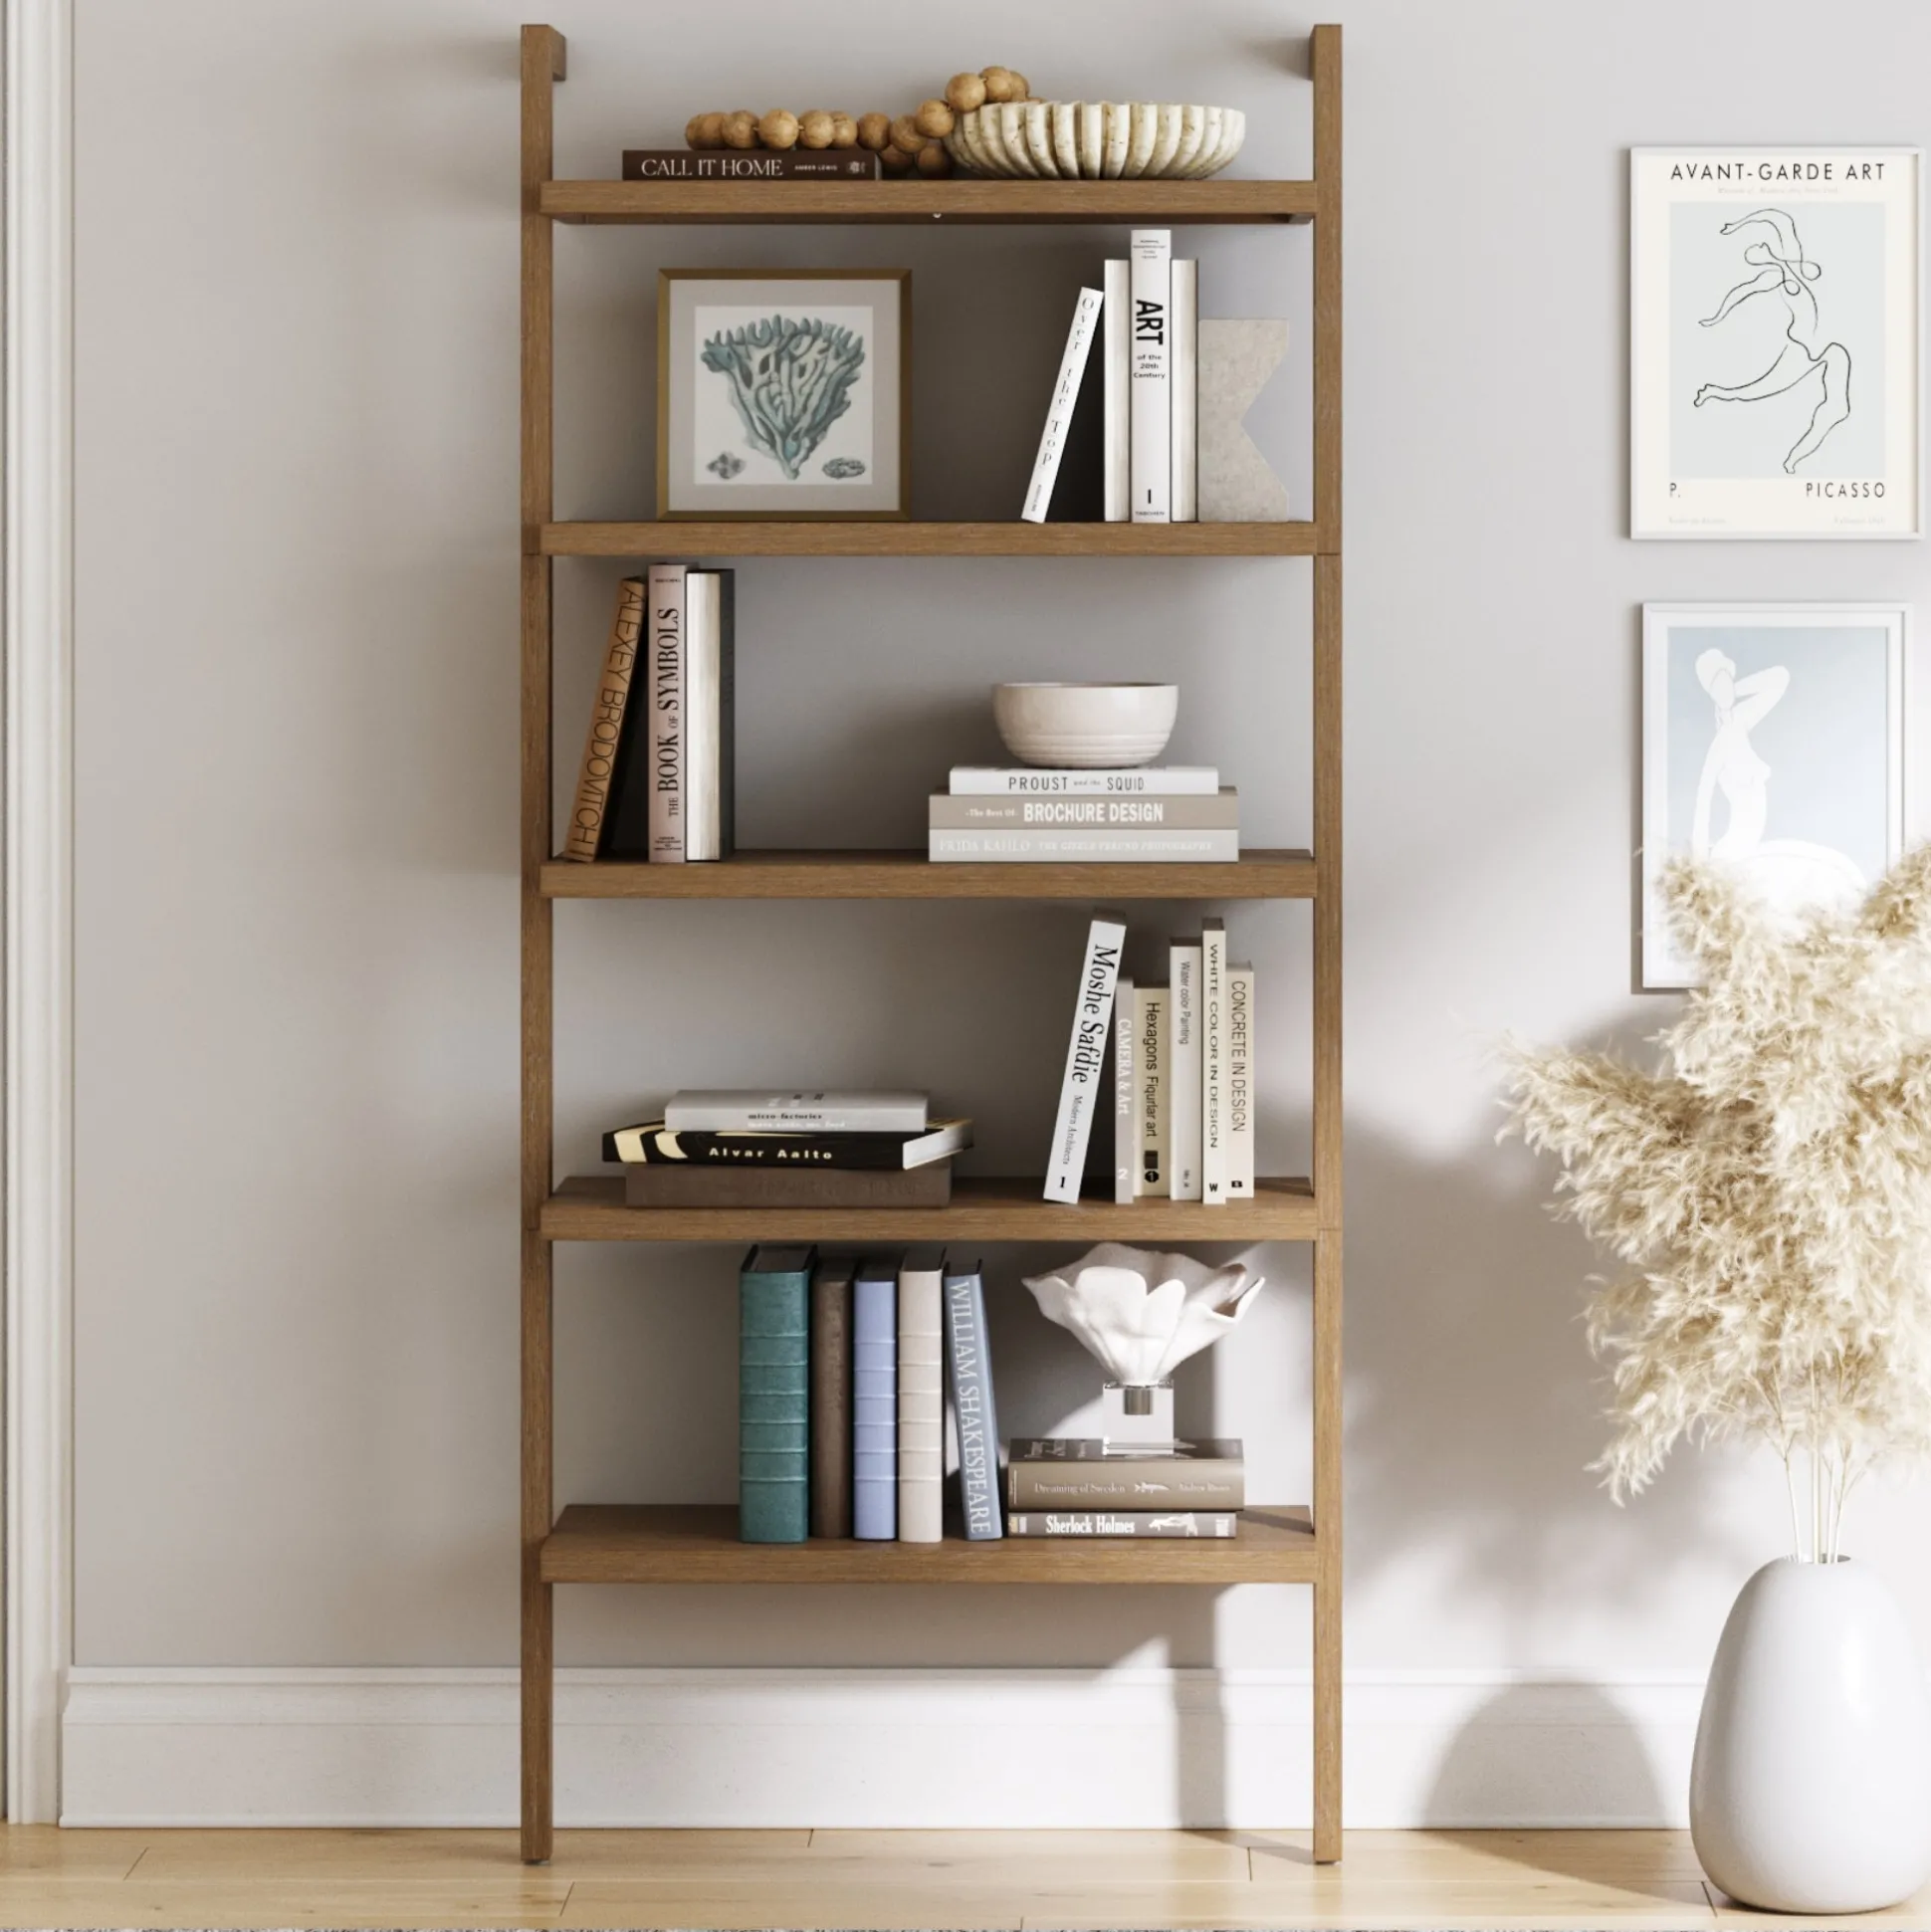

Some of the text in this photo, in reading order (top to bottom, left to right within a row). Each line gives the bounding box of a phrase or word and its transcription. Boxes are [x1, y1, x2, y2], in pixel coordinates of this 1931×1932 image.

[641, 158, 783, 176] CALL IT HOME
[1670, 162, 1885, 181] AVANT-GARDE ART
[1136, 299, 1164, 345] ART
[1133, 371, 1167, 380] Century
[1668, 482, 1681, 499] P.
[1806, 482, 1885, 499] PICASSO
[657, 607, 679, 711] SYMBOLS
[571, 587, 644, 845] ALEXEY BRODOVITCH
[657, 735, 679, 793] BOOK
[1008, 776, 1068, 791] PROUST
[1107, 776, 1145, 791] SQUID
[668, 797, 679, 818] THE
[1024, 803, 1164, 822] BROCHURE DESIGN
[939, 839, 979, 852] FRIDA
[983, 839, 1031, 852] KAHLO
[1179, 961, 1191, 1045] Water color Painting
[1072, 945, 1118, 1083] Moshe Safdie
[1143, 1002, 1161, 1071] Hexagons
[1208, 944, 1218, 1149] WHITE COLOR IN DESIGN
[1231, 980, 1246, 1133] CONCRETE IN DESIGN
[1118, 1018, 1133, 1116] CAMERA & Art
[1146, 1122, 1159, 1137] art
[709, 1147, 833, 1160] Alvar Aalto
[1118, 1168, 1129, 1181] 2
[949, 1281, 991, 1534] WILLIAM SHAKESPEARE
[1034, 1482, 1079, 1495] Dreaming
[1089, 1482, 1126, 1494] Sweden
[1046, 1515, 1136, 1534] Sherlock Holmes
